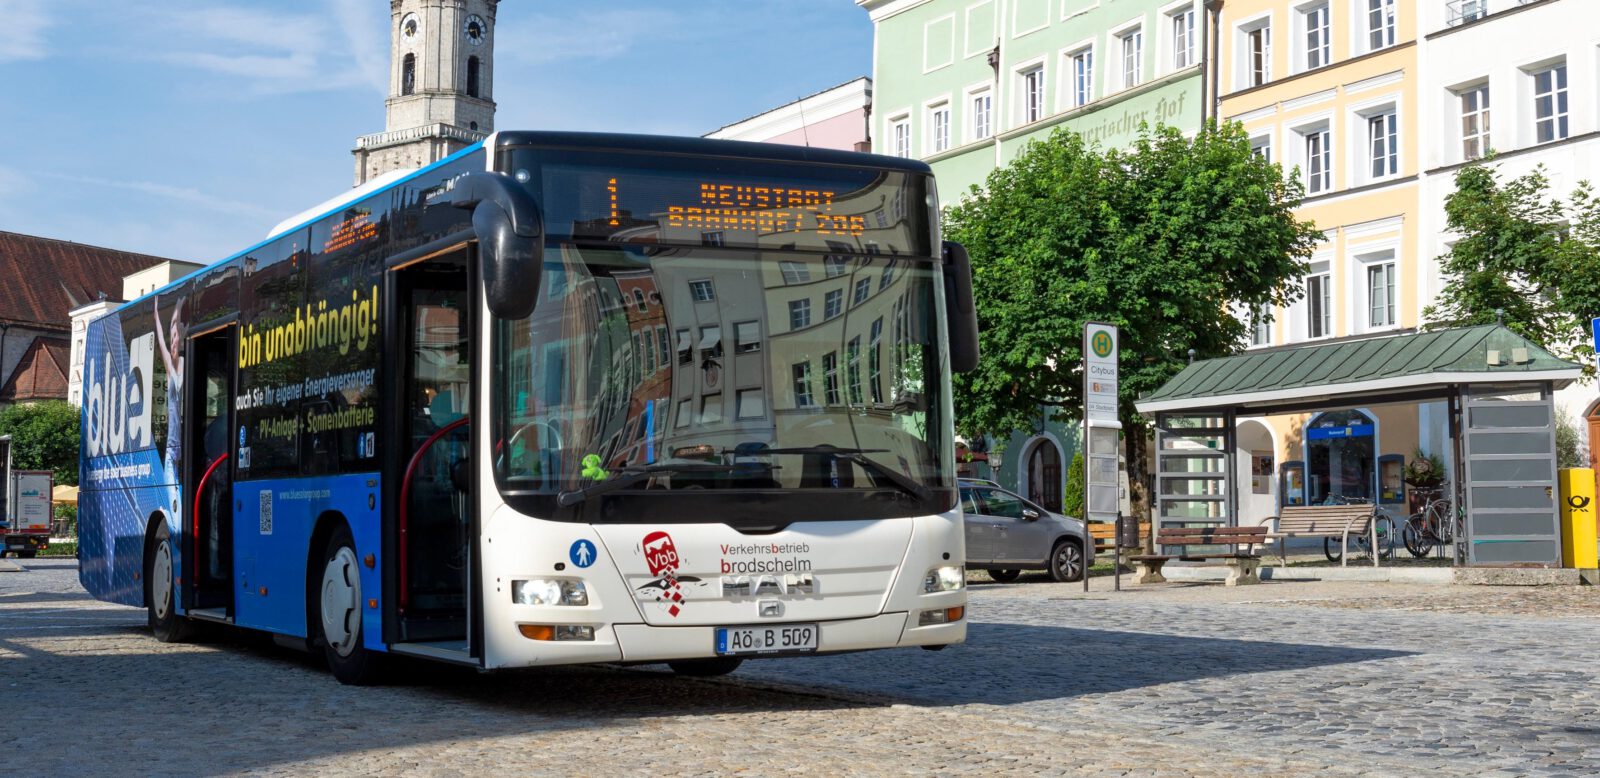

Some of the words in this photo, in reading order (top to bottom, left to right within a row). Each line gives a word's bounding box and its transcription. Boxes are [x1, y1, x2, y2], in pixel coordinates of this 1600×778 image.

[1155, 90, 1187, 121] Hof
[607, 178, 619, 226] 1
[701, 184, 835, 211] NEUSTADT
[239, 323, 261, 369] bin
[265, 284, 378, 362] unabhängig!
[1090, 365, 1115, 376] Citybus
[235, 388, 252, 411] auch
[252, 387, 264, 407] Sie
[264, 385, 275, 405] Ihr
[275, 382, 303, 407] eigener
[304, 368, 376, 399] Energieversorger
[259, 415, 298, 441] PV-Anlage
[307, 402, 374, 434] Sonnenbatterie
[120, 463, 138, 478] business
[138, 463, 150, 479] group
[648, 549, 677, 569] Vbb
[720, 543, 810, 556] Verkehrsbetrieb
[720, 557, 812, 574] brodschelm
[720, 574, 814, 599] MAN
[731, 630, 753, 649] AÖ
[765, 629, 775, 647] B
[781, 628, 812, 647] 509
